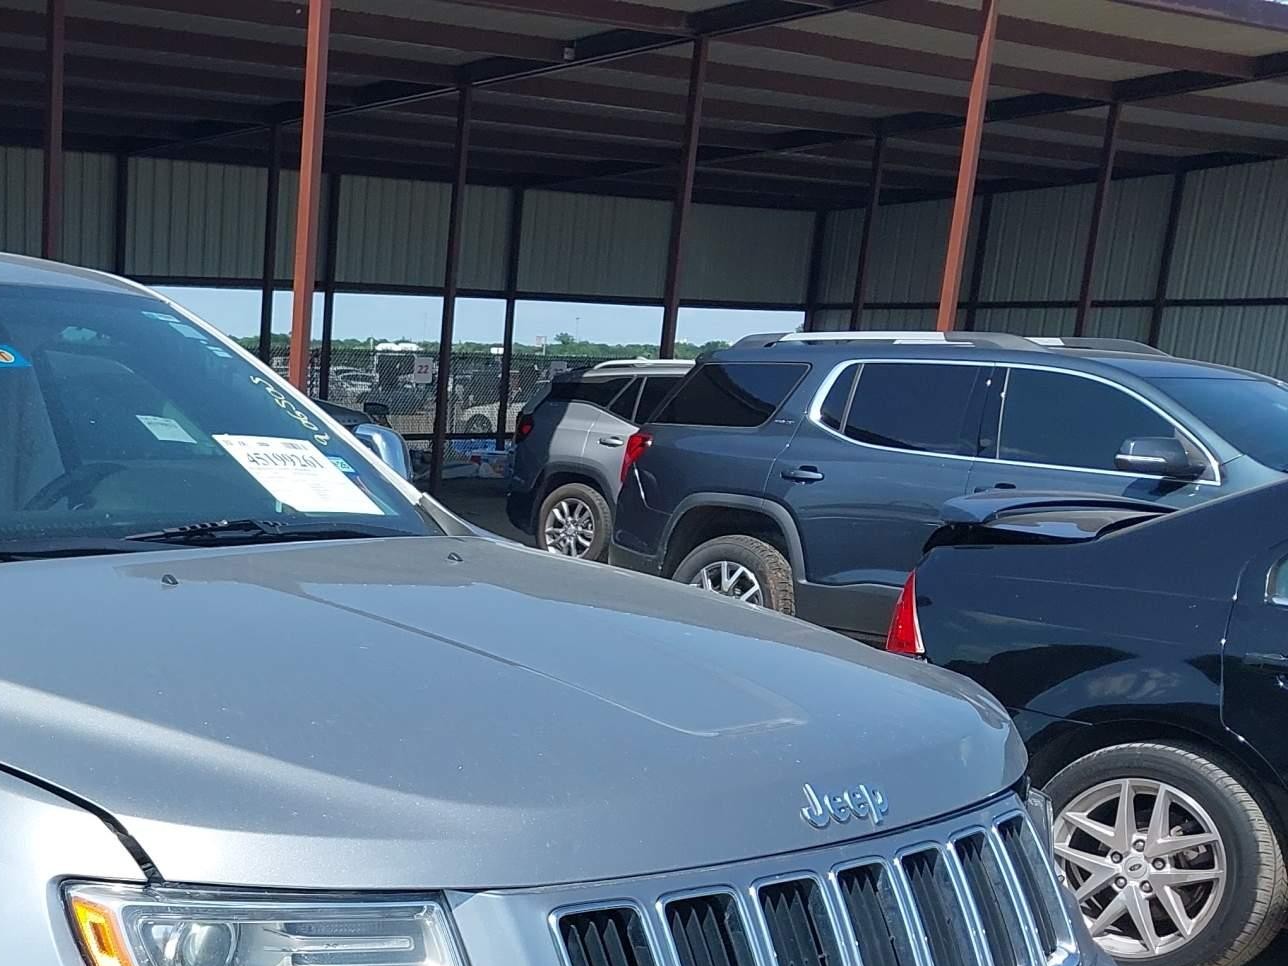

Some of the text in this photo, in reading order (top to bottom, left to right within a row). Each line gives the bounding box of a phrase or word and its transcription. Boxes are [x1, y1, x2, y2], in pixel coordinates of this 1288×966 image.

[416, 363, 430, 375] 22
[245, 451, 325, 470] 45199261
[799, 782, 889, 828] Jeep
